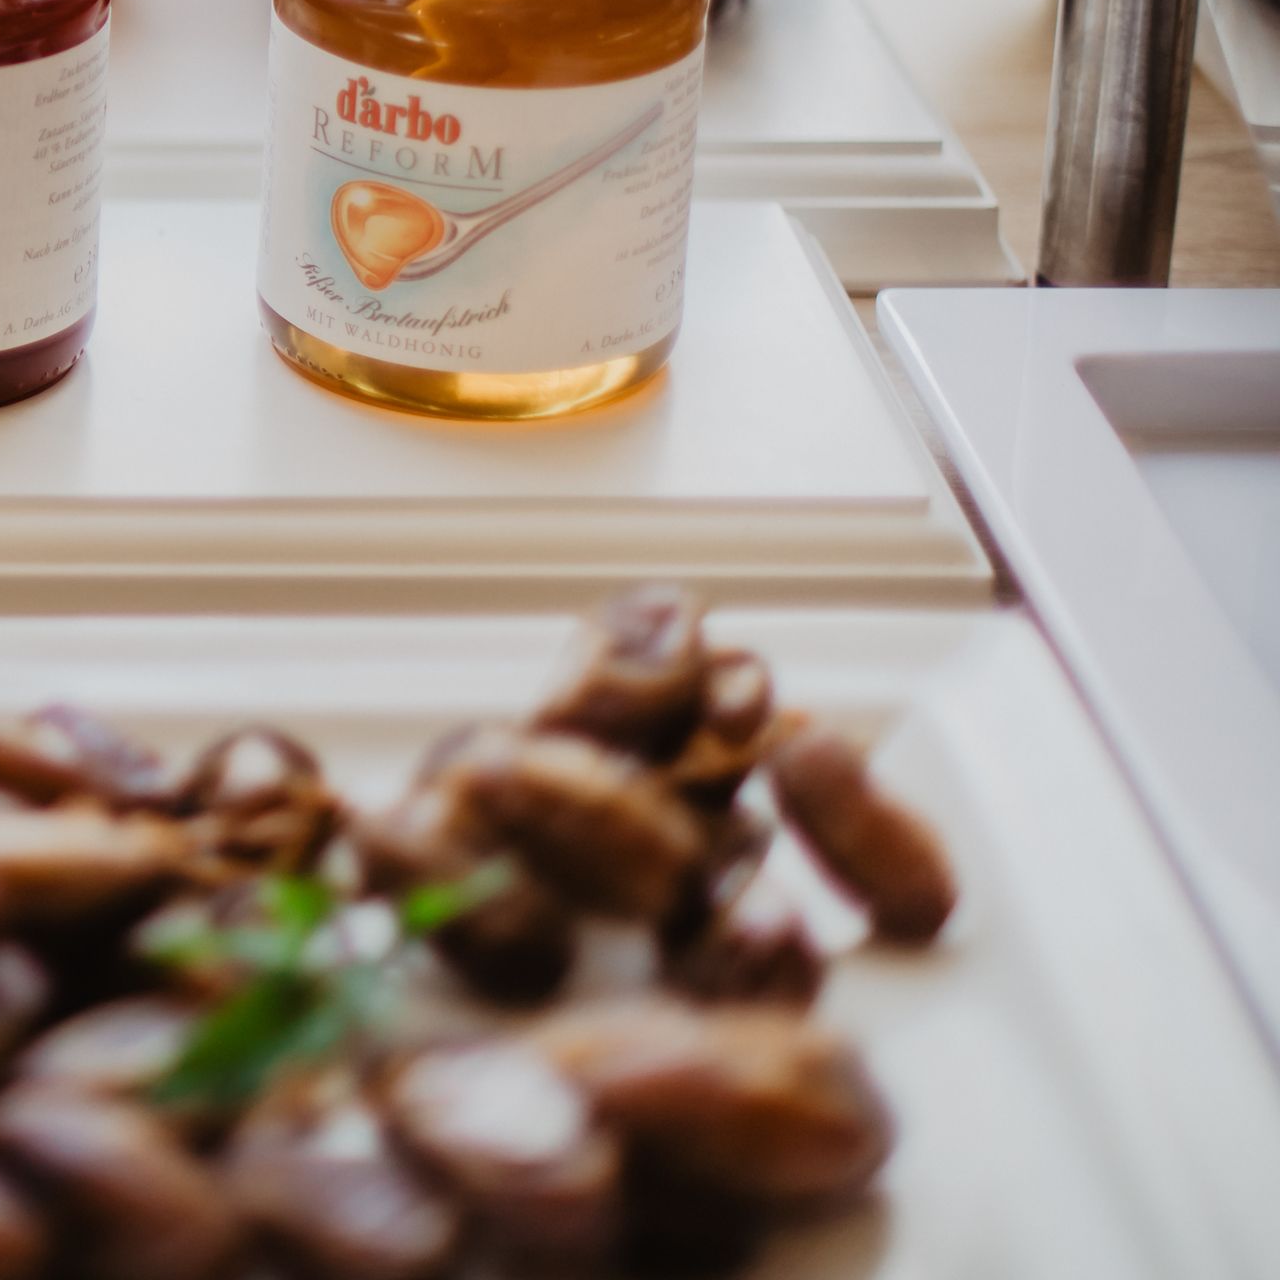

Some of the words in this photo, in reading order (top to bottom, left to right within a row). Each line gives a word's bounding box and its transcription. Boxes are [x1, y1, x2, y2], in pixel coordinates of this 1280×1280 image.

[312, 105, 505, 181] REFORM
[305, 304, 336, 330] MIT
[345, 287, 514, 338] Brotaufstrich
